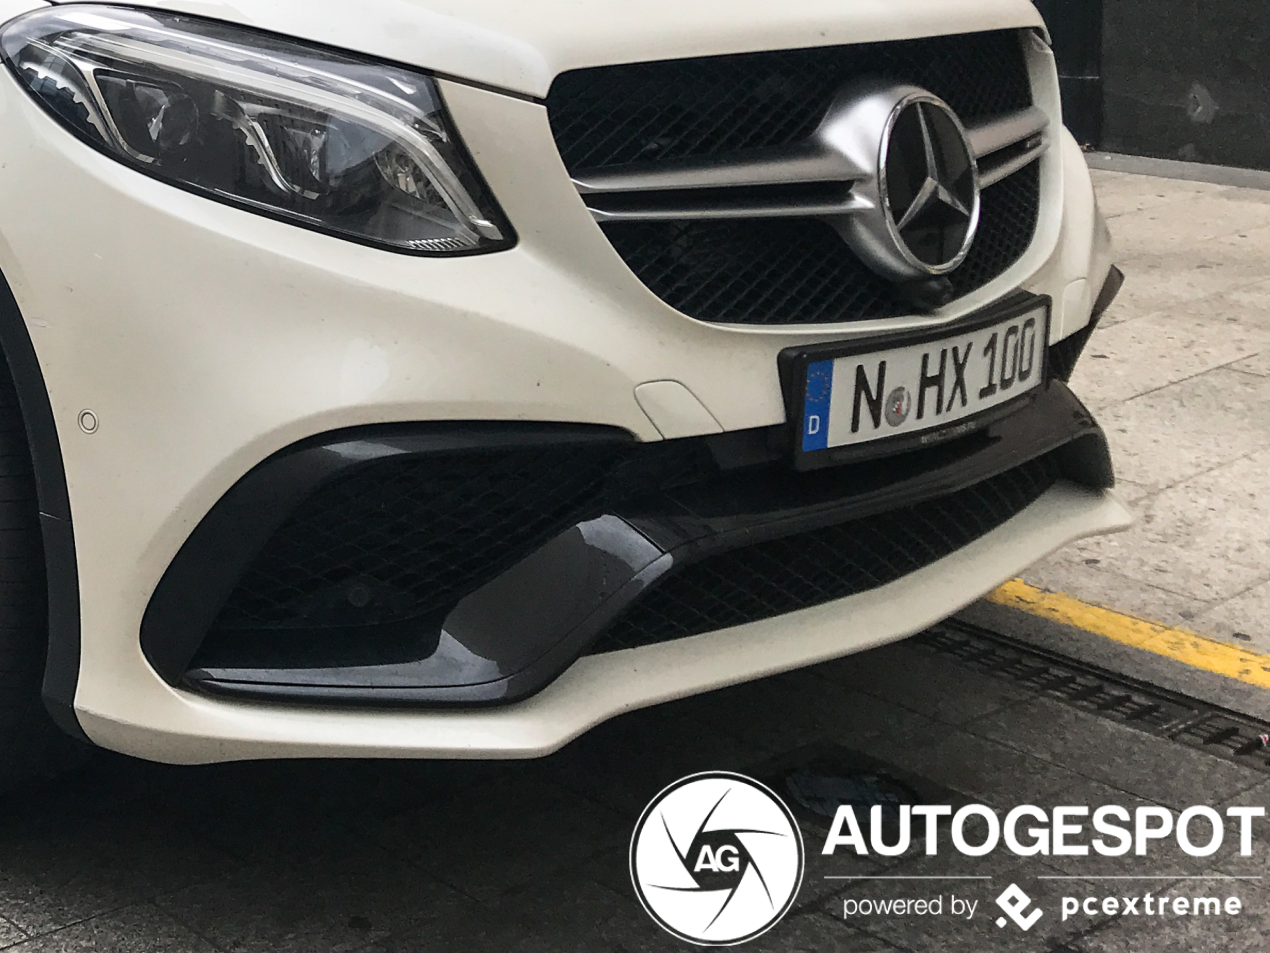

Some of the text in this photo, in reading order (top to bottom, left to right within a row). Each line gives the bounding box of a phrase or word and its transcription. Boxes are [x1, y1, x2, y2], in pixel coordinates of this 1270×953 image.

[850, 317, 1036, 434] N HX 100
[807, 414, 820, 435] D
